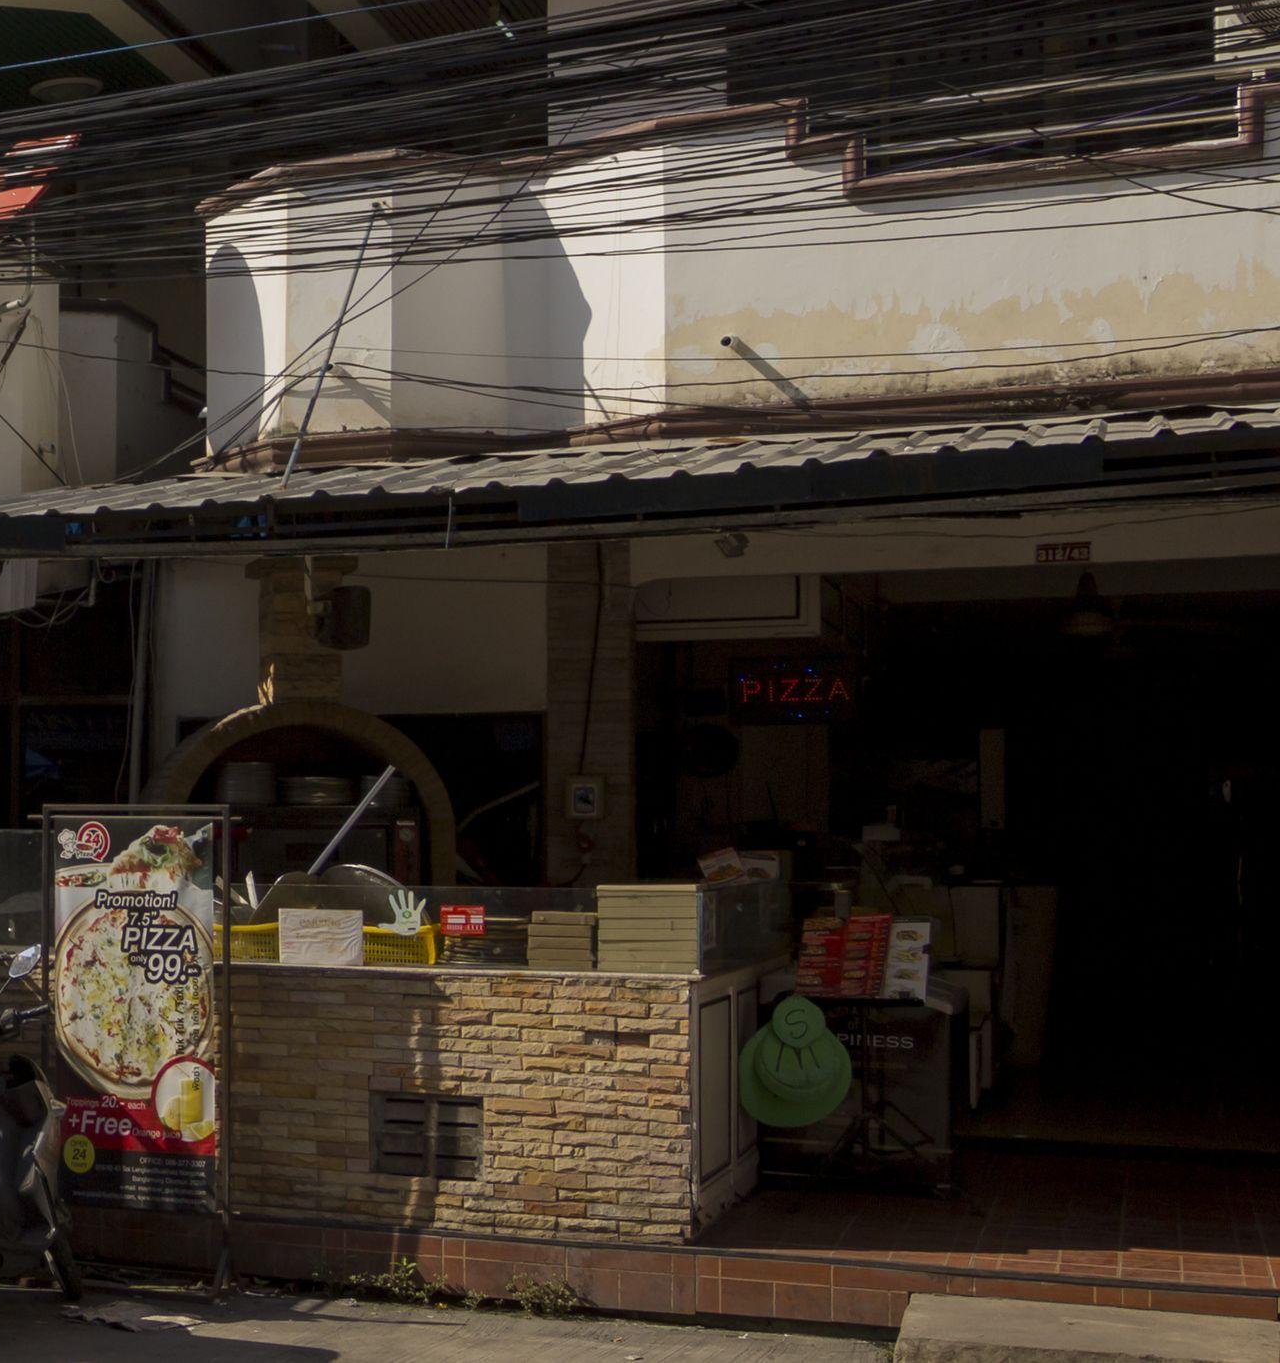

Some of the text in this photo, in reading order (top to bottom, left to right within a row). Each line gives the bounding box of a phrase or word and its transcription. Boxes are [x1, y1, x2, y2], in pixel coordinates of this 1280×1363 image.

[742, 678, 851, 703] PIZZA
[85, 832, 101, 846] 24
[97, 892, 176, 908] Promotion!
[129, 911, 157, 925] 7.5"
[124, 928, 196, 950] PIZZA
[130, 953, 147, 965] only
[175, 986, 185, 1006] Taxi
[175, 1014, 185, 1033] Tuk
[175, 1038, 185, 1055] Tuk
[127, 1101, 146, 1110] each
[132, 1129, 161, 1139] Orange
[162, 1129, 181, 1141] juice
[72, 1149, 87, 1160] 24
